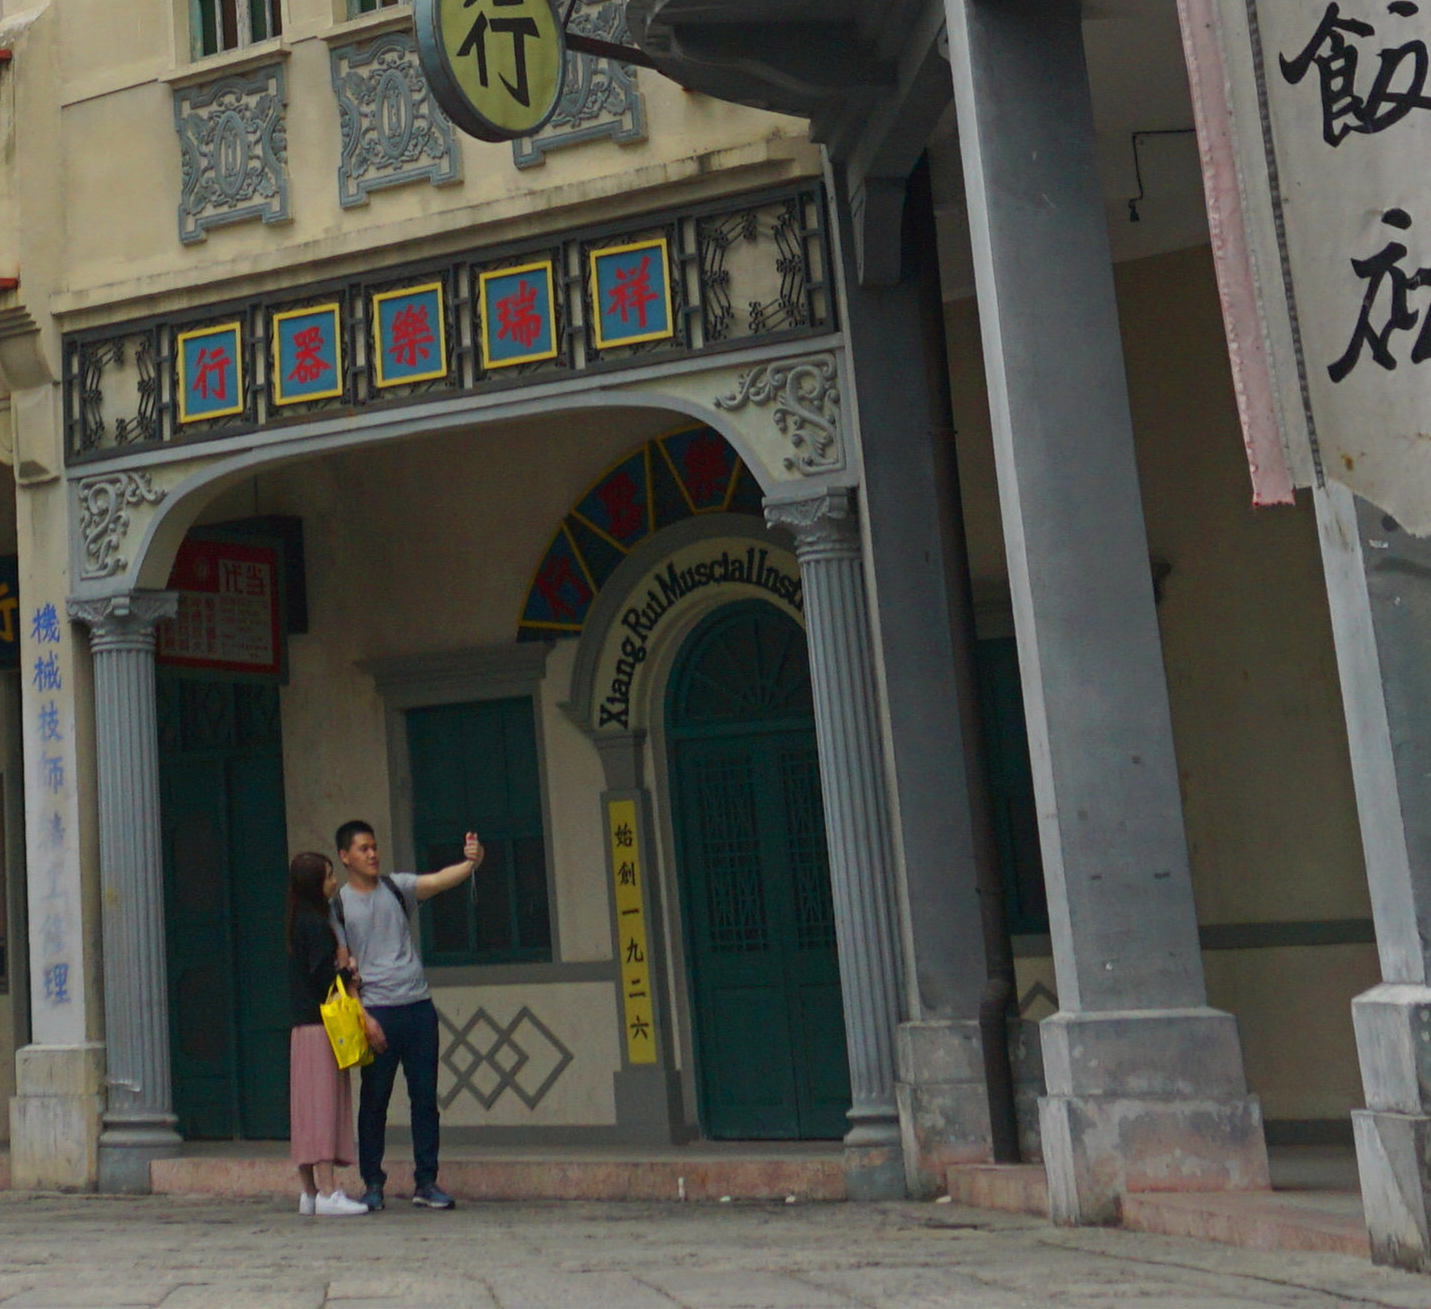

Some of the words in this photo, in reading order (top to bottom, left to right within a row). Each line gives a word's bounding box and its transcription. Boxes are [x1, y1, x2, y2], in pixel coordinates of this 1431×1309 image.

[192, 256, 660, 402] 祥瑞樂器行
[621, 590, 667, 640] Rui
[598, 635, 647, 730] Xiang
[614, 822, 649, 1039] 始創一九二六
